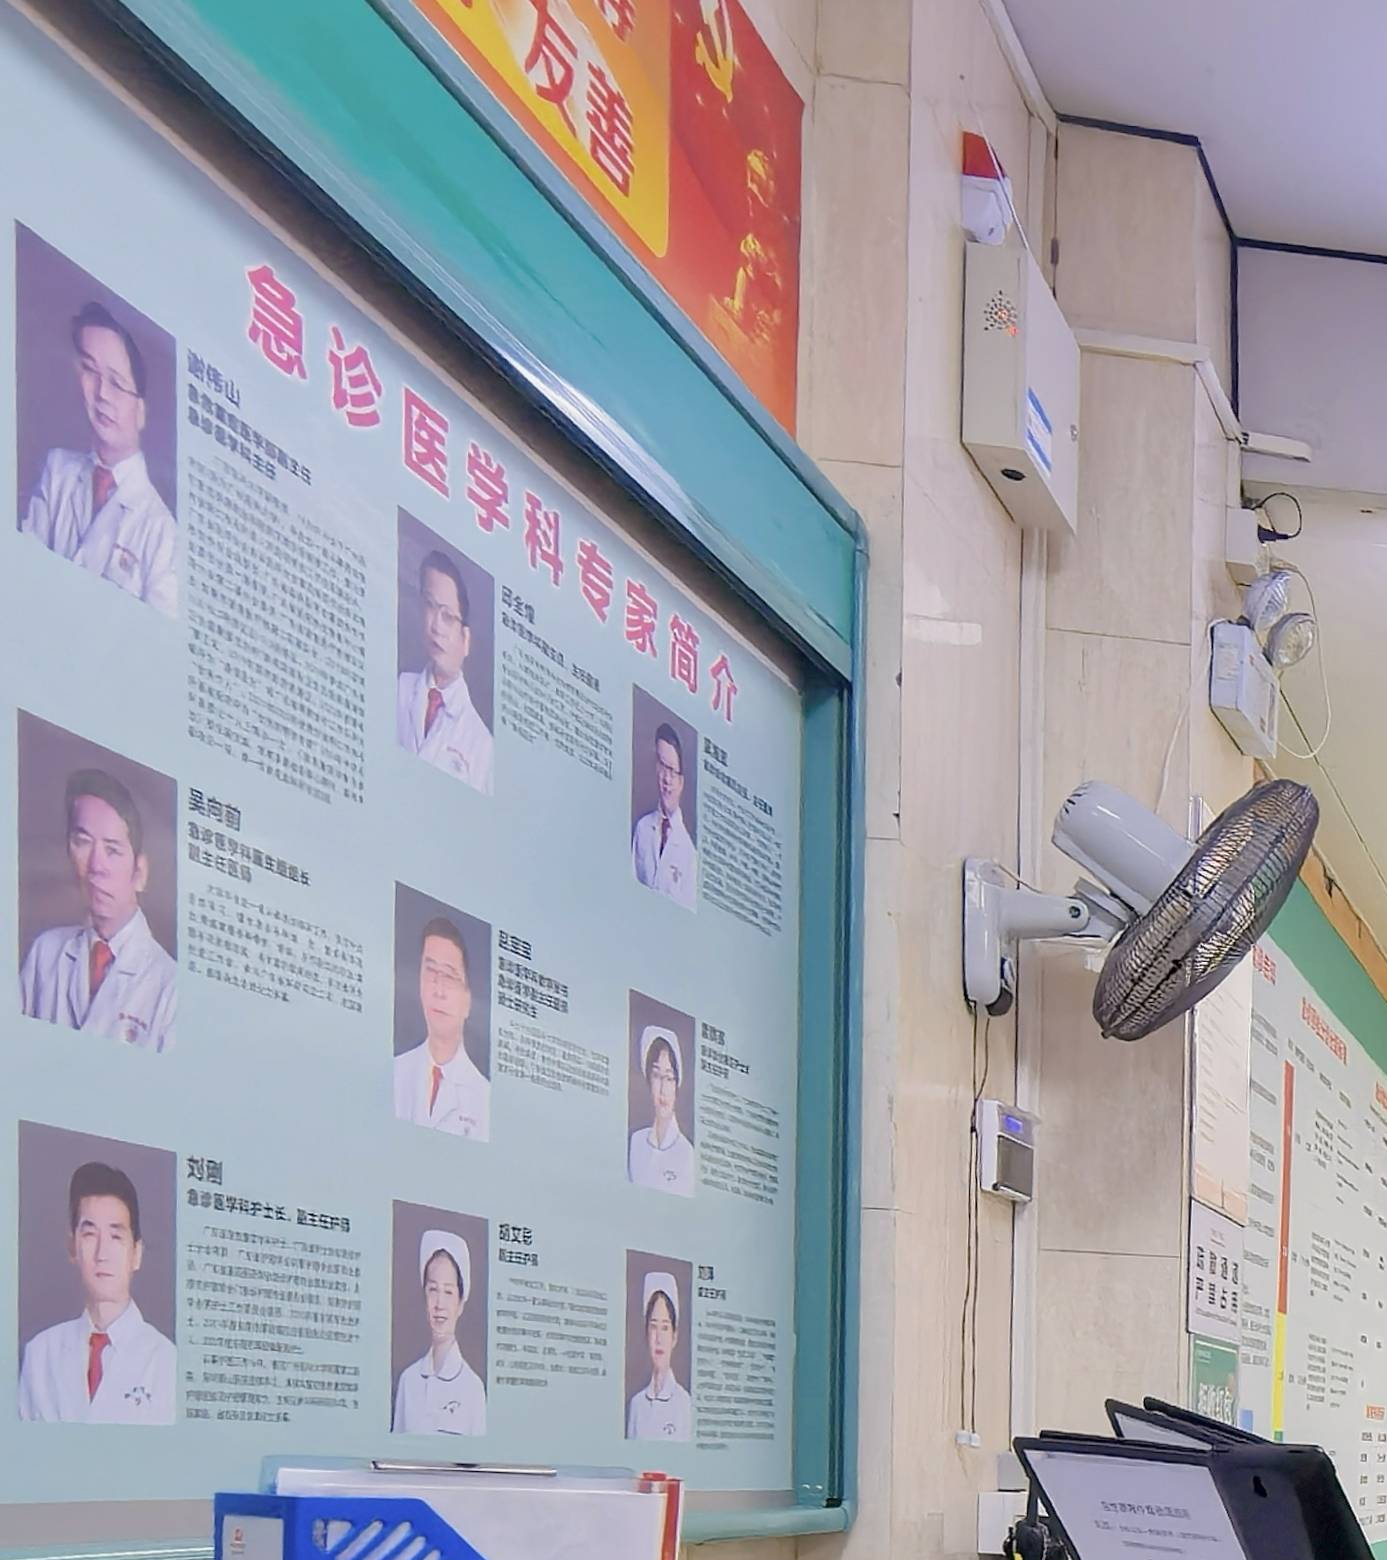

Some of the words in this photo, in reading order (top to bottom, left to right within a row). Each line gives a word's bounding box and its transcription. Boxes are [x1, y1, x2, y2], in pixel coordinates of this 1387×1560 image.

[246, 263, 740, 723] 急诊医学科专家简介
